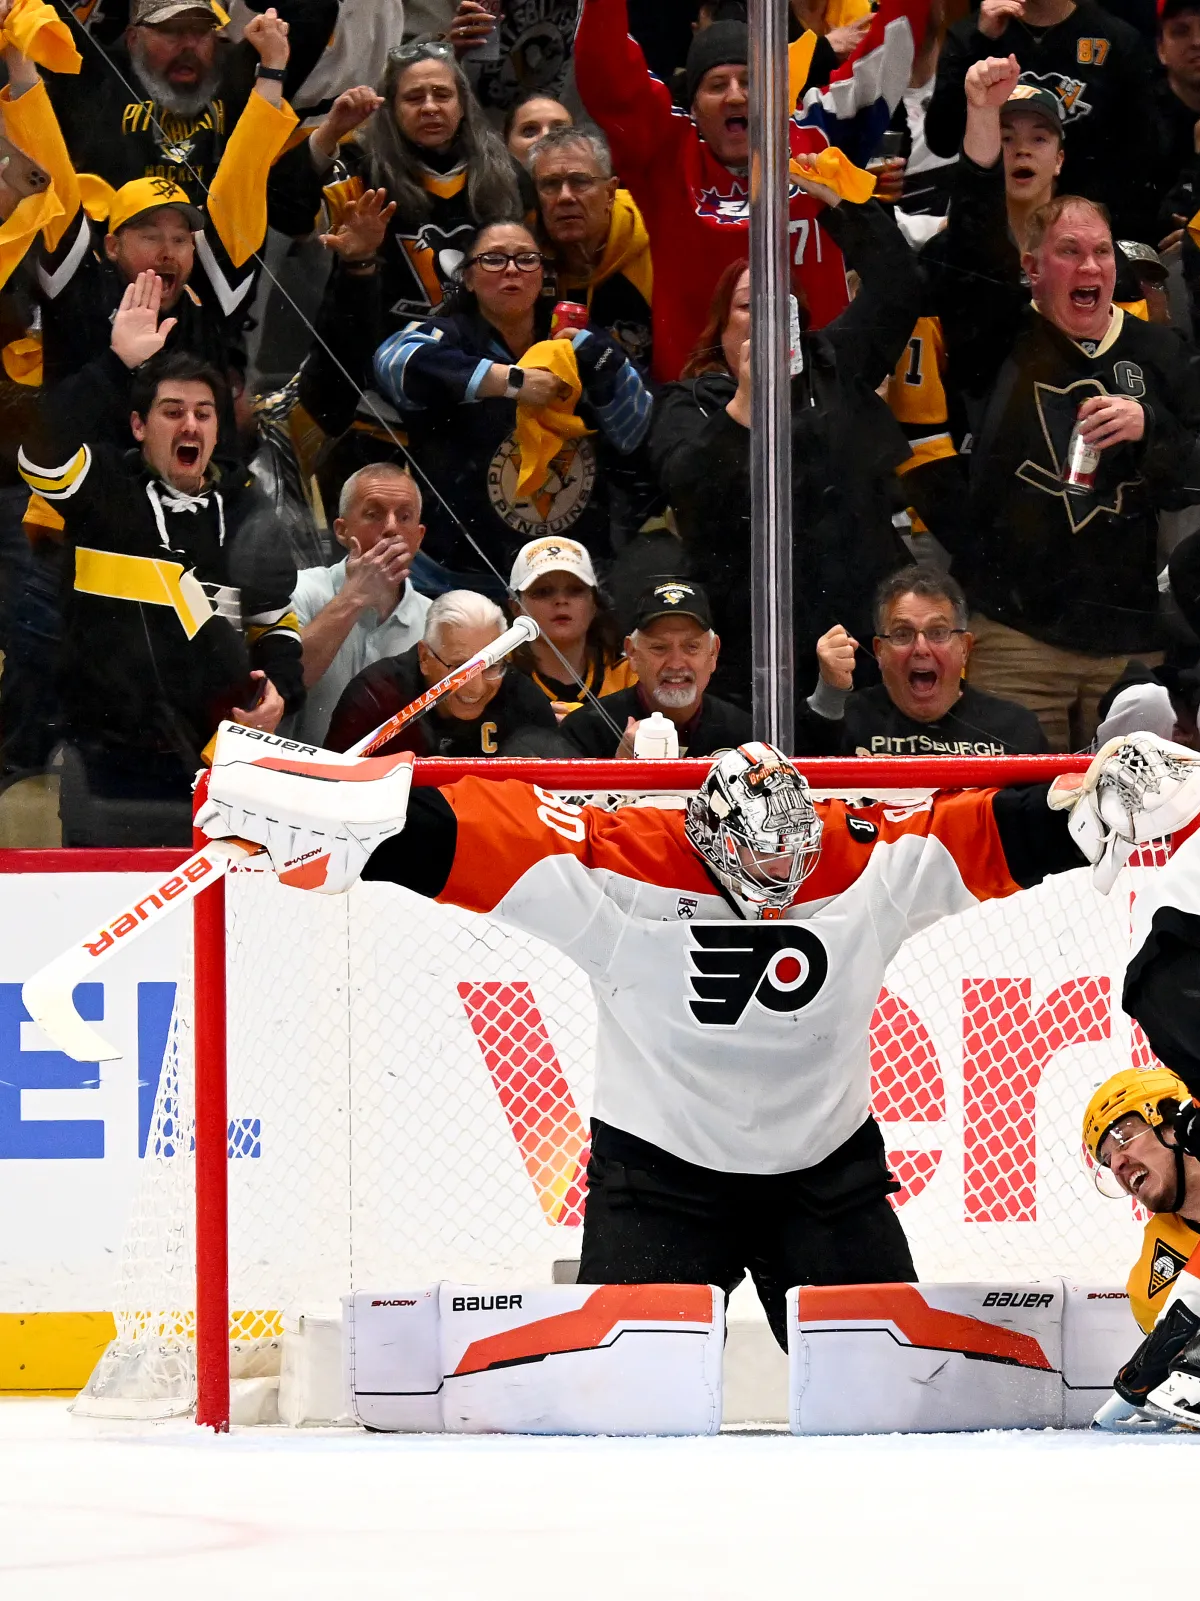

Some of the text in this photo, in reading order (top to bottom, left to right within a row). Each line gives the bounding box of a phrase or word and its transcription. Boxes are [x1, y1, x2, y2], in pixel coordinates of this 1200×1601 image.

[1077, 38, 1109, 65] 87
[1113, 361, 1146, 398] C
[481, 721, 498, 753] C
[871, 735, 1005, 756] PITTSBURGH
[284, 846, 322, 867] SHADOW
